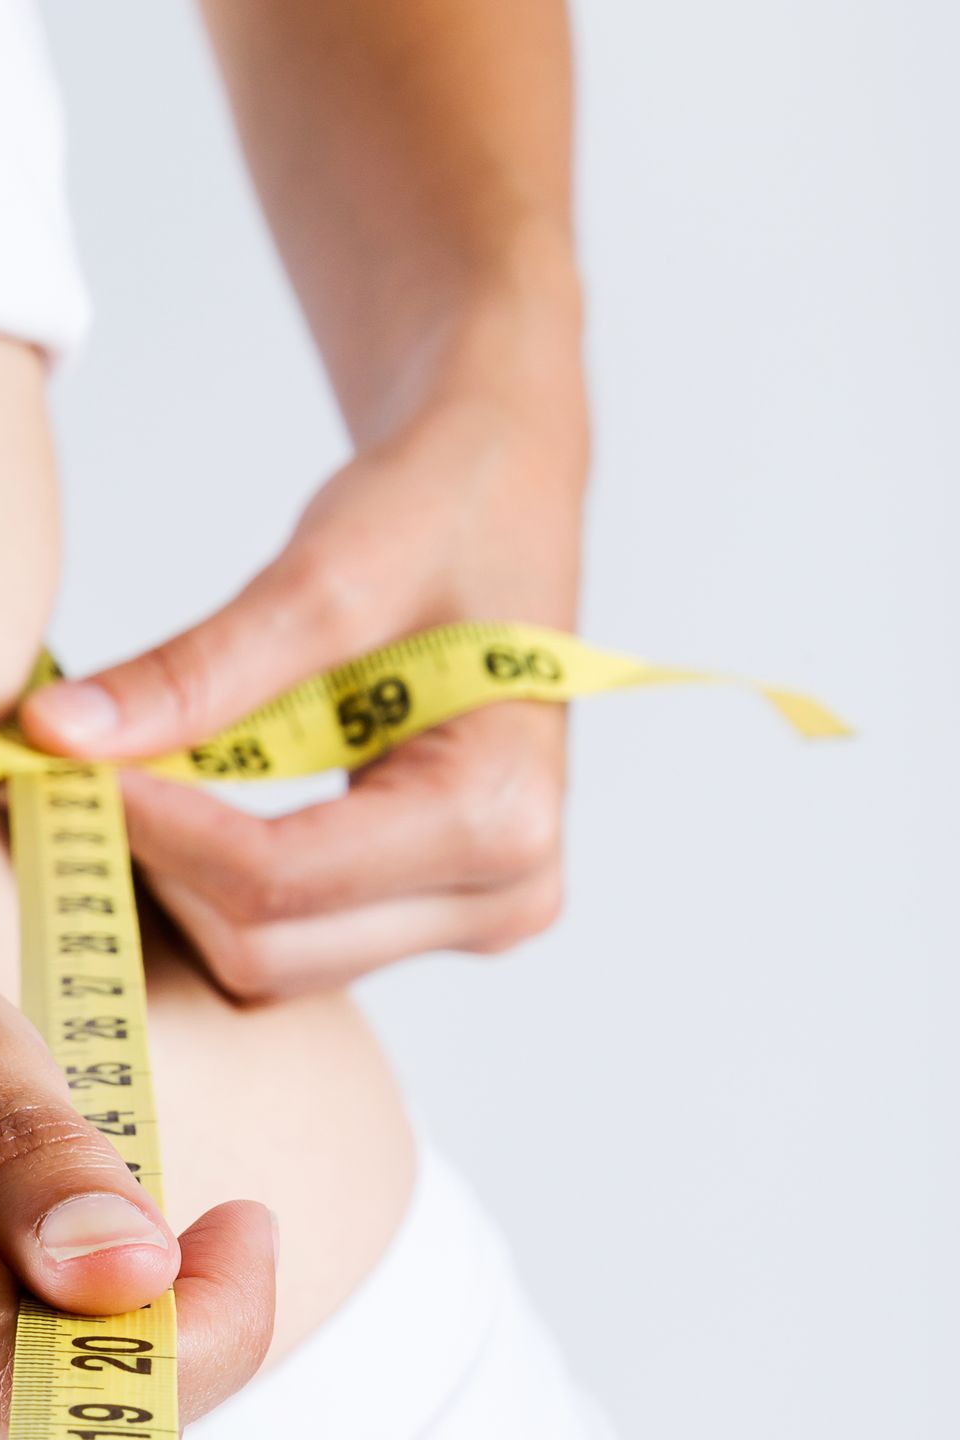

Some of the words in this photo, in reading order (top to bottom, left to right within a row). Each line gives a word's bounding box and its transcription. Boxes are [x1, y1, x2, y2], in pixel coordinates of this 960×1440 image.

[484, 645, 563, 684] 60
[337, 676, 411, 747] 59
[189, 738, 269, 775] 58
[61, 975, 123, 997] 27
[63, 1016, 127, 1041] 26
[66, 1062, 131, 1089] 25
[70, 1336, 153, 1375] 20
[67, 1404, 153, 1440] 19
